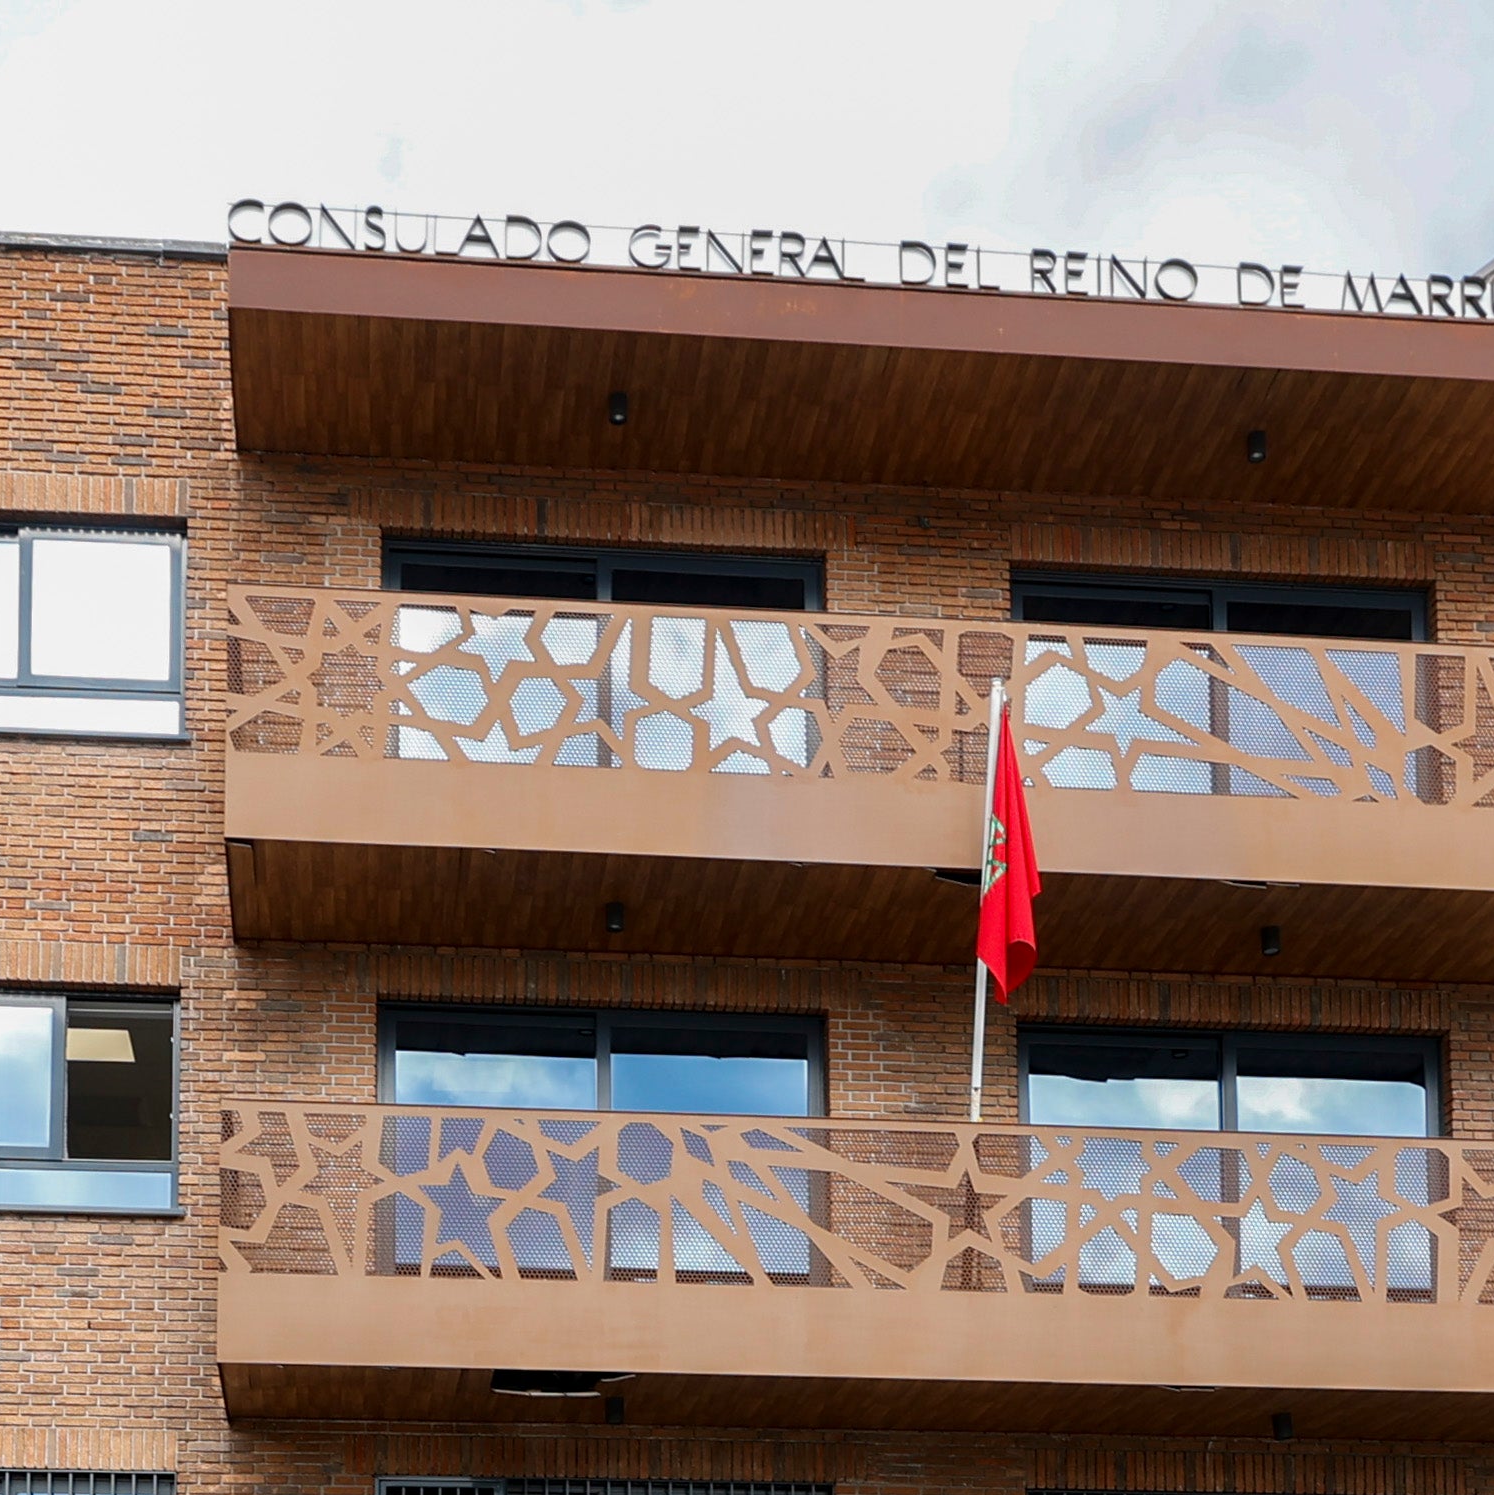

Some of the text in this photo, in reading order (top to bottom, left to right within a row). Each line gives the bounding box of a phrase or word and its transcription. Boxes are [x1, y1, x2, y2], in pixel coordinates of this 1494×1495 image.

[228, 198, 591, 264] CONSULADO
[628, 224, 865, 283] GENERAL
[899, 240, 1000, 291] DEL
[1030, 248, 1199, 302] REINO
[1236, 262, 1306, 309] DE
